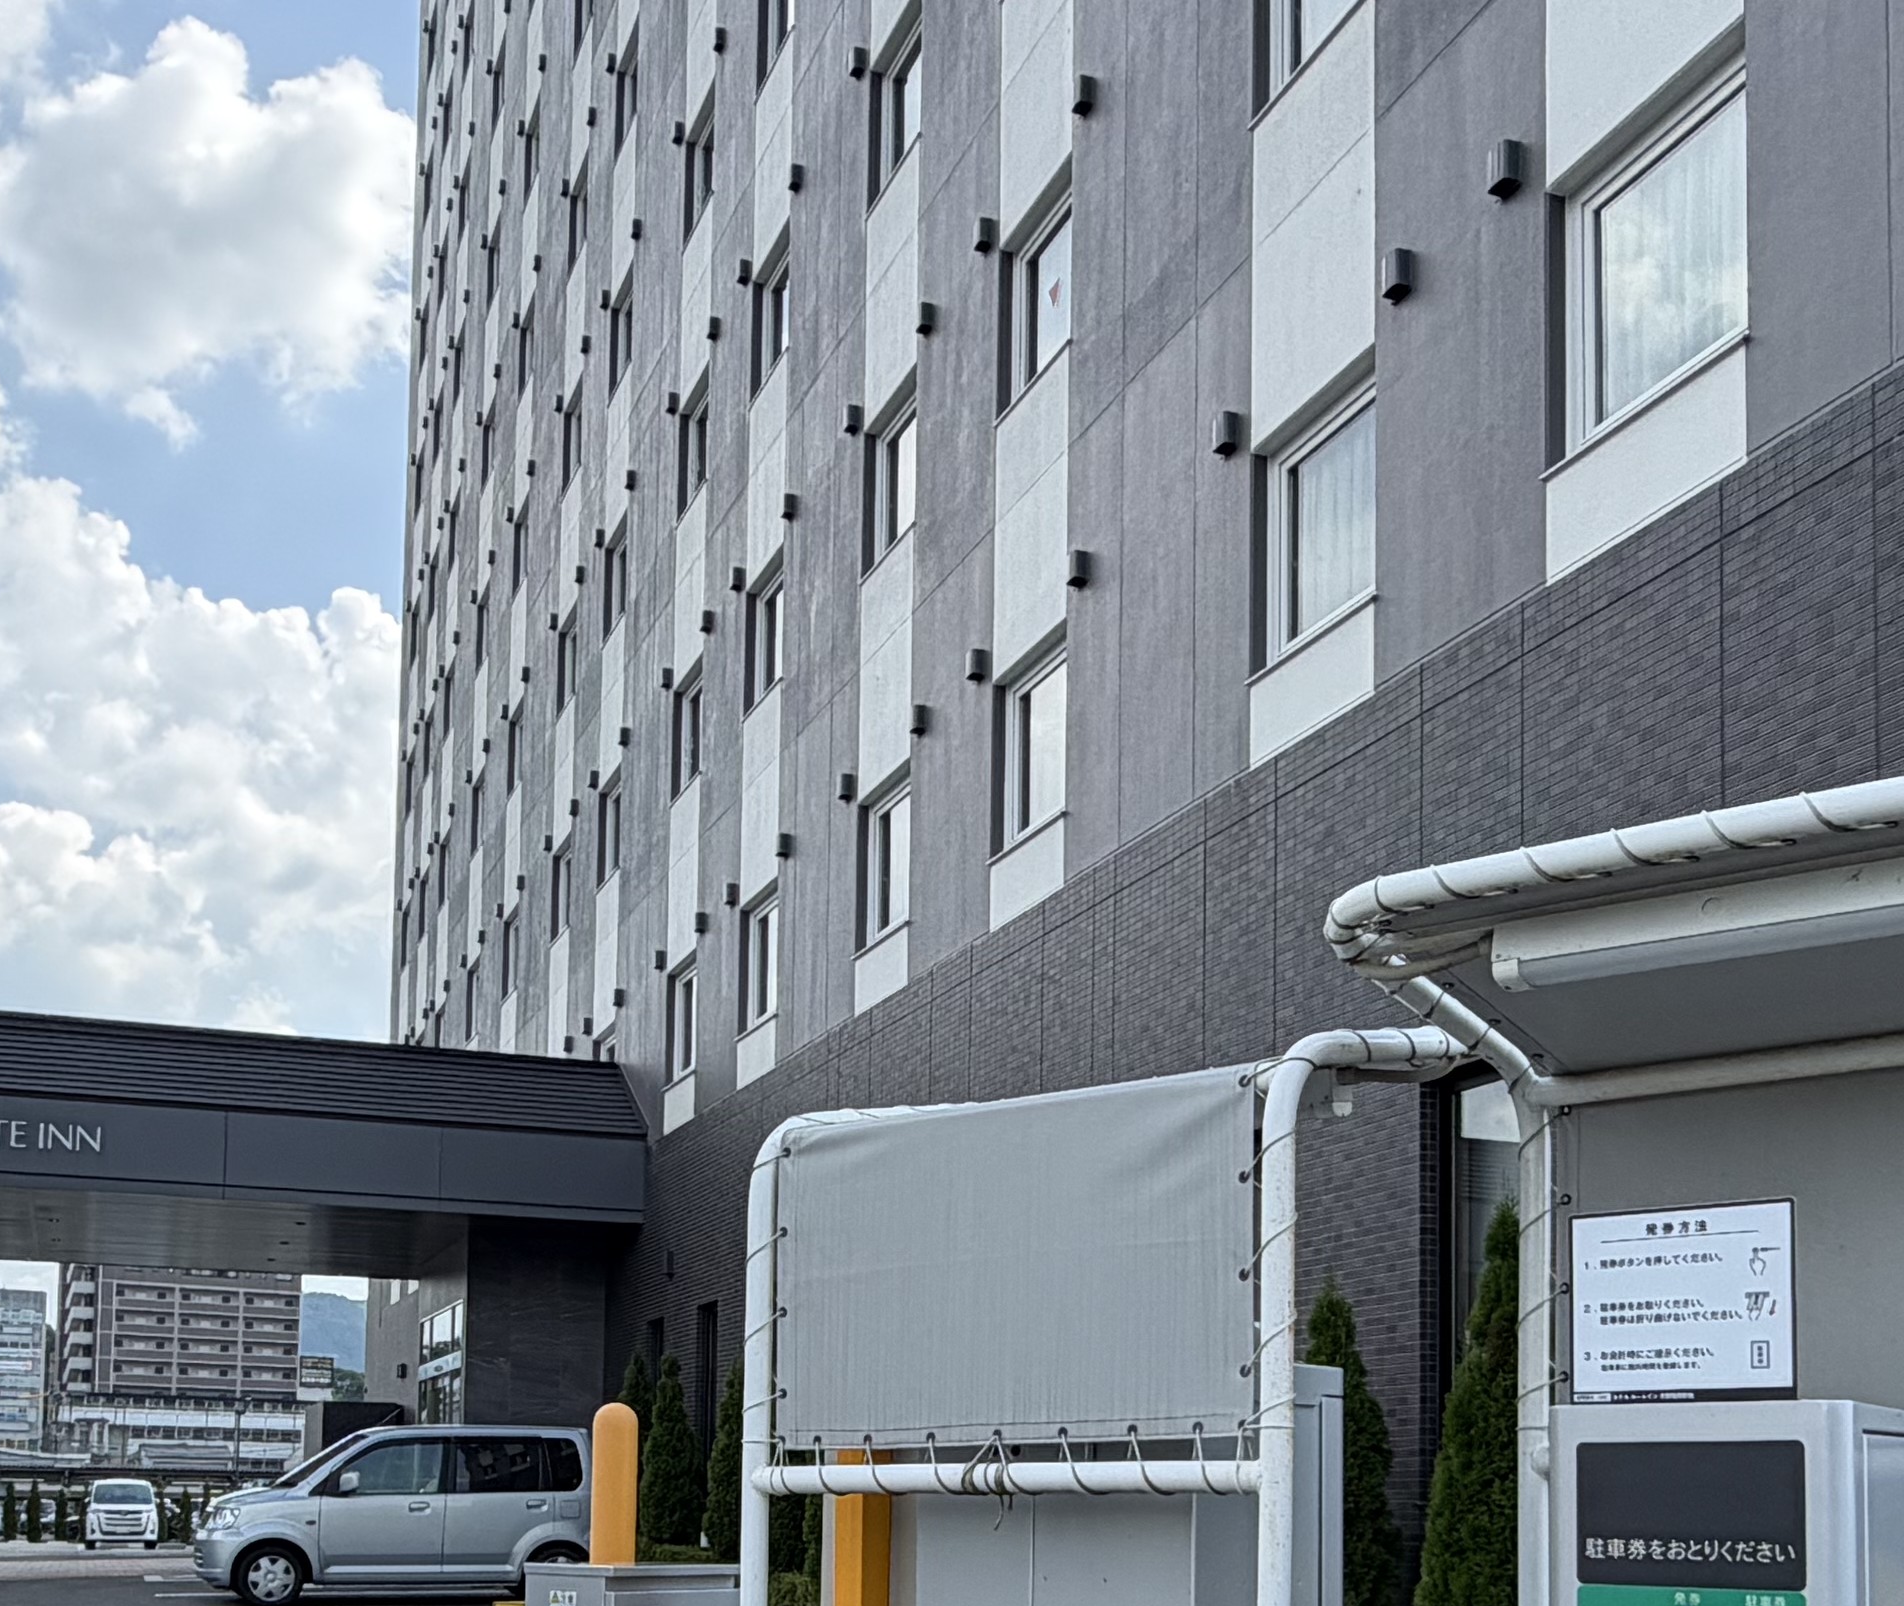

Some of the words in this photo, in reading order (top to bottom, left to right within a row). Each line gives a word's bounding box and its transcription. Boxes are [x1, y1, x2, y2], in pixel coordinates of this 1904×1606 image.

[38, 1123, 102, 1152] INN
[1584, 1537, 1796, 1562] 駐車券をおとりください
